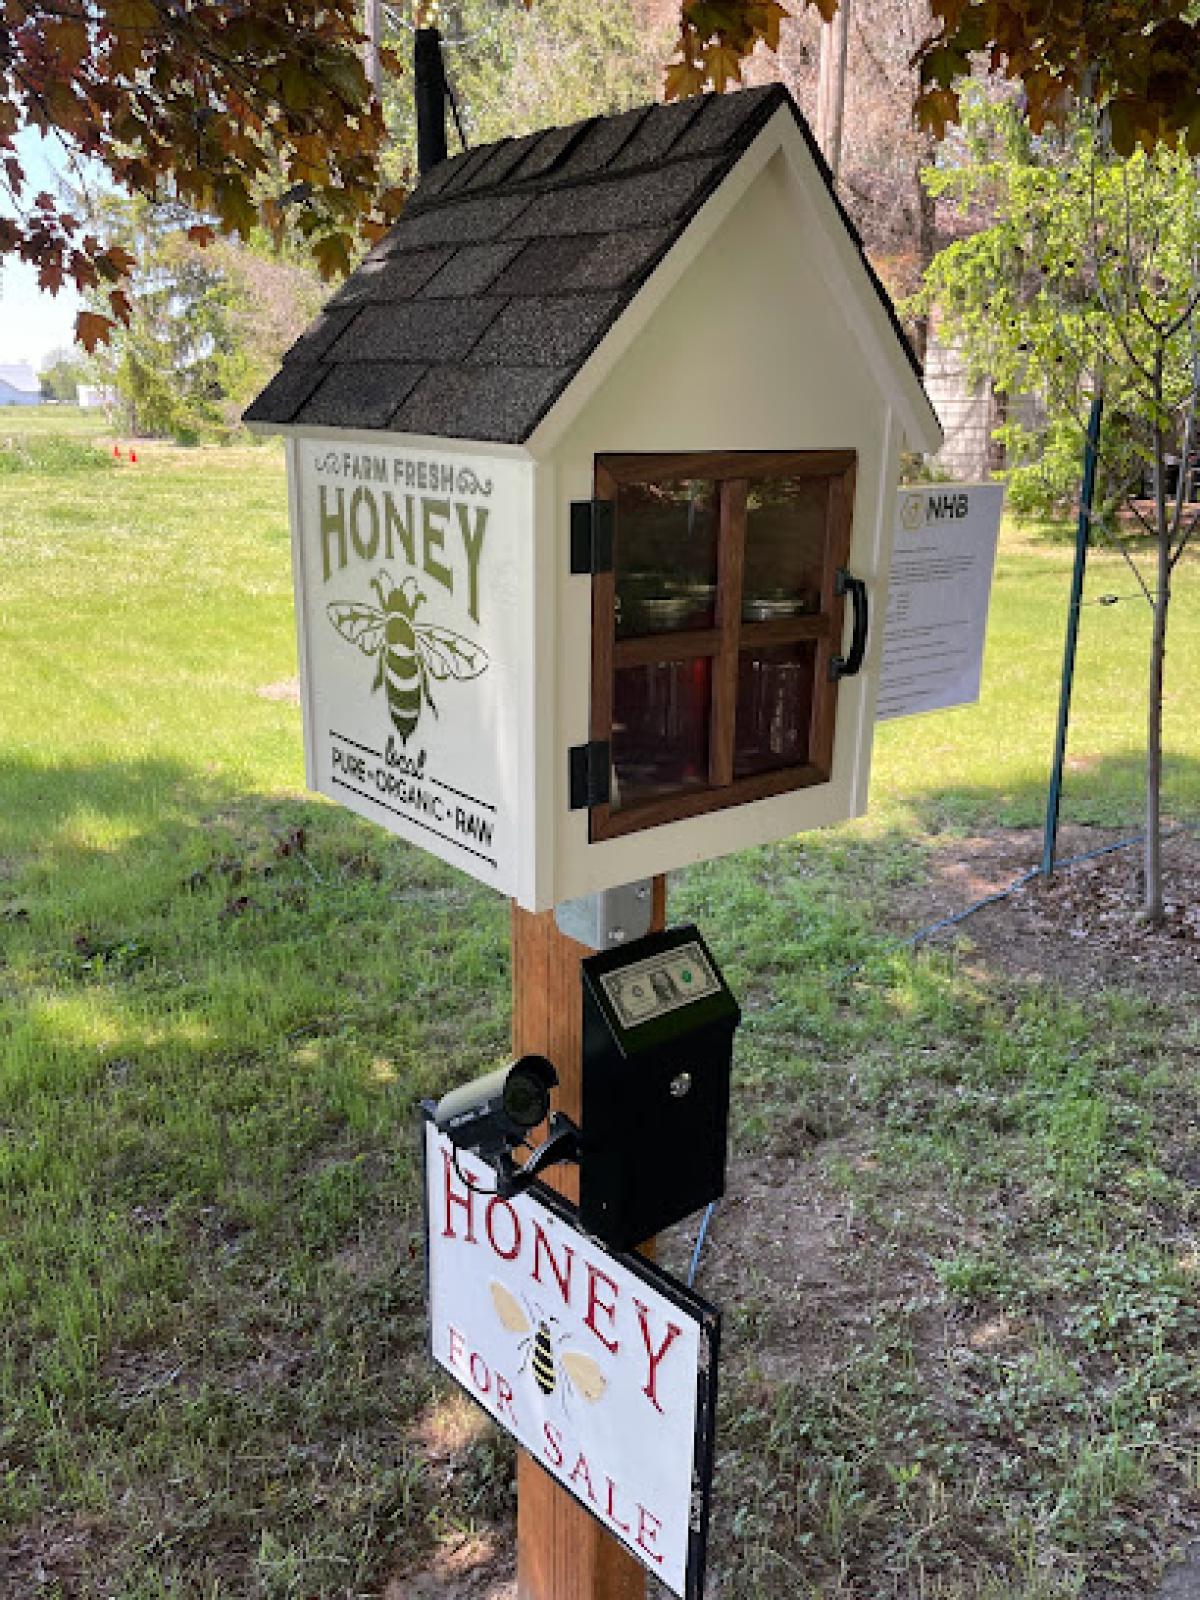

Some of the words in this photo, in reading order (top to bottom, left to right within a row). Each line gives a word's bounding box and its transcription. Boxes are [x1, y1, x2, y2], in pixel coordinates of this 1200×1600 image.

[343, 452, 388, 483] FARM
[393, 458, 454, 492] FRESH
[926, 493, 969, 519] NHB
[318, 484, 490, 626] HONEY
[455, 805, 495, 848] RAW
[439, 1146, 683, 1416] HONEY
[447, 1322, 519, 1428] FOR
[543, 1419, 664, 1564] SALE
